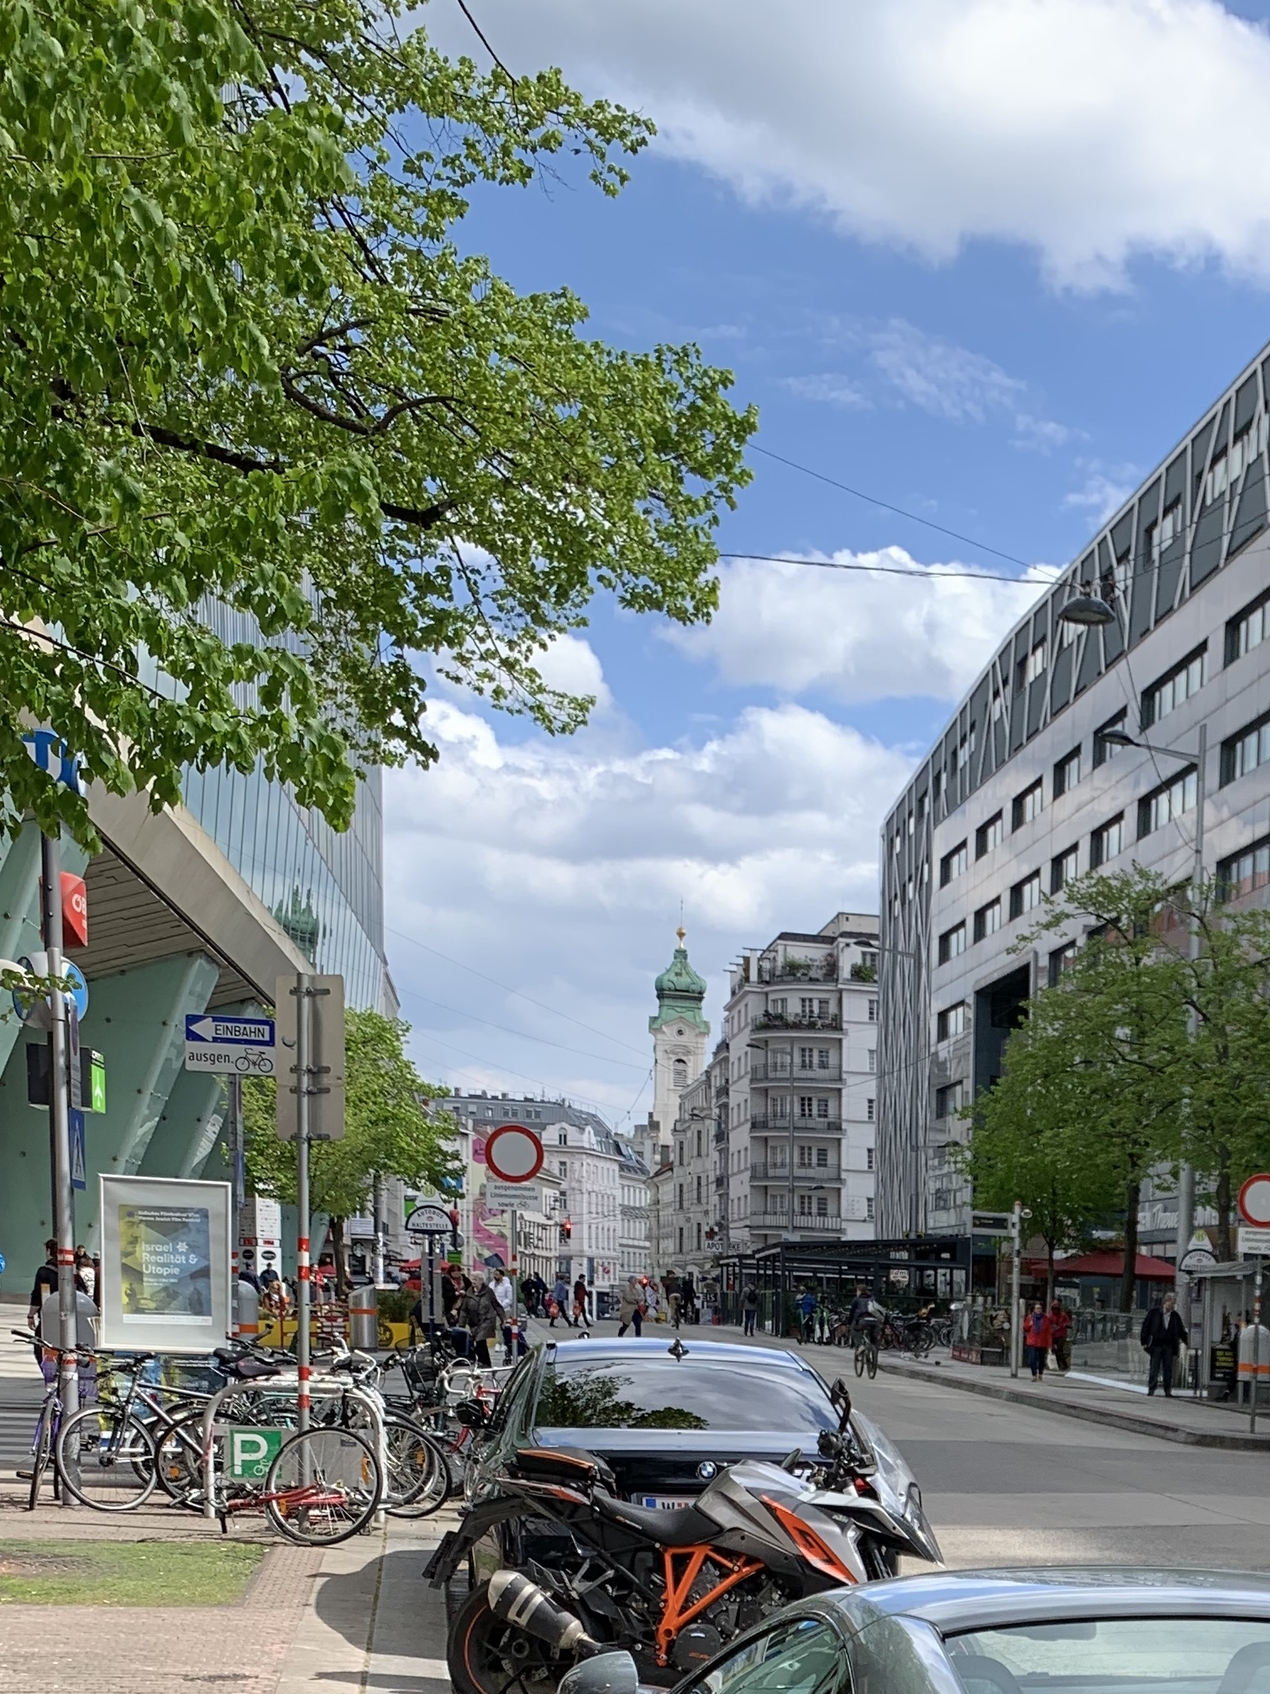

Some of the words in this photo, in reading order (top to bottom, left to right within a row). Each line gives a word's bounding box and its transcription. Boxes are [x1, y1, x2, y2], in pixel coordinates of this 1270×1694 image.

[214, 1024, 266, 1040] EINBAHN
[188, 1052, 235, 1066] ausgen.
[416, 1209, 445, 1219] AUTOBUS
[142, 1242, 173, 1252] Israel
[142, 1252, 187, 1263] Realität
[189, 1254, 198, 1264] &
[143, 1264, 180, 1276] Utopie
[233, 1433, 268, 1475] P
